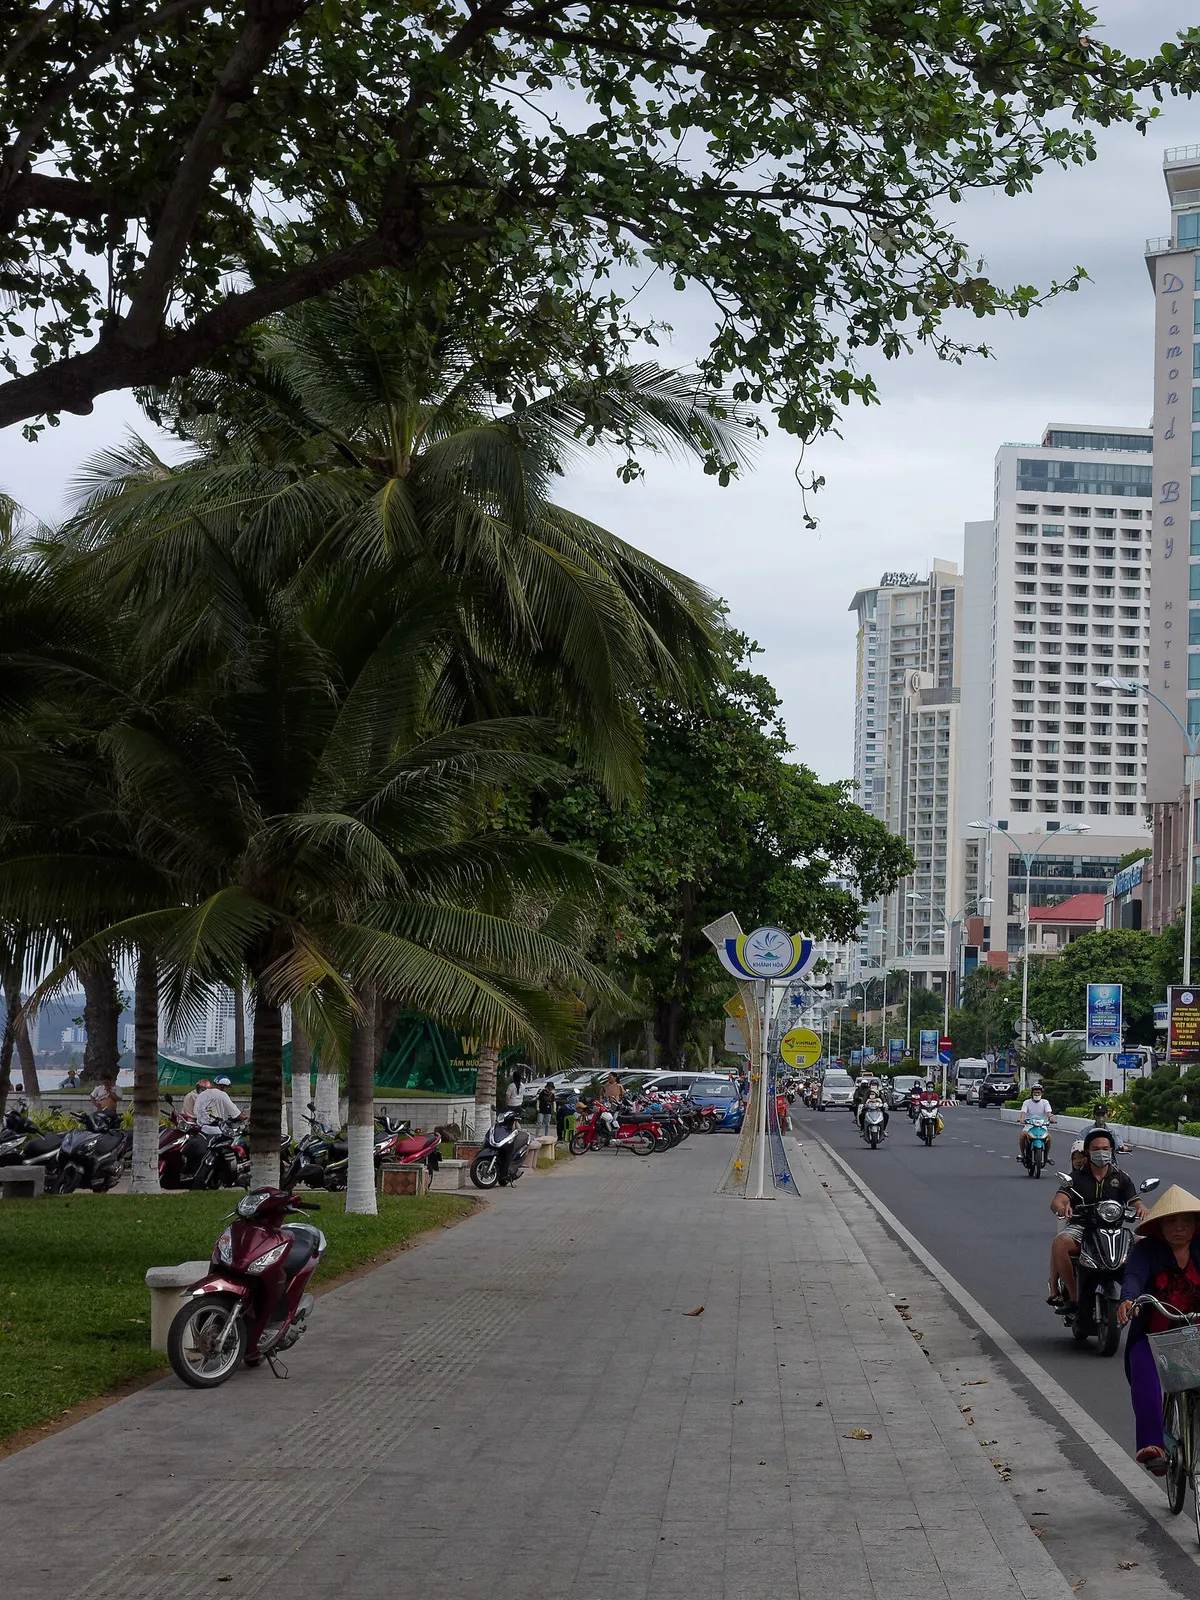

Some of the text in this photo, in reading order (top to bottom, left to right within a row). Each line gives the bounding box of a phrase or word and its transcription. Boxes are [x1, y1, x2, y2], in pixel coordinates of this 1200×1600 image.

[1159, 272, 1184, 690] Diamond Bay HOTEL
